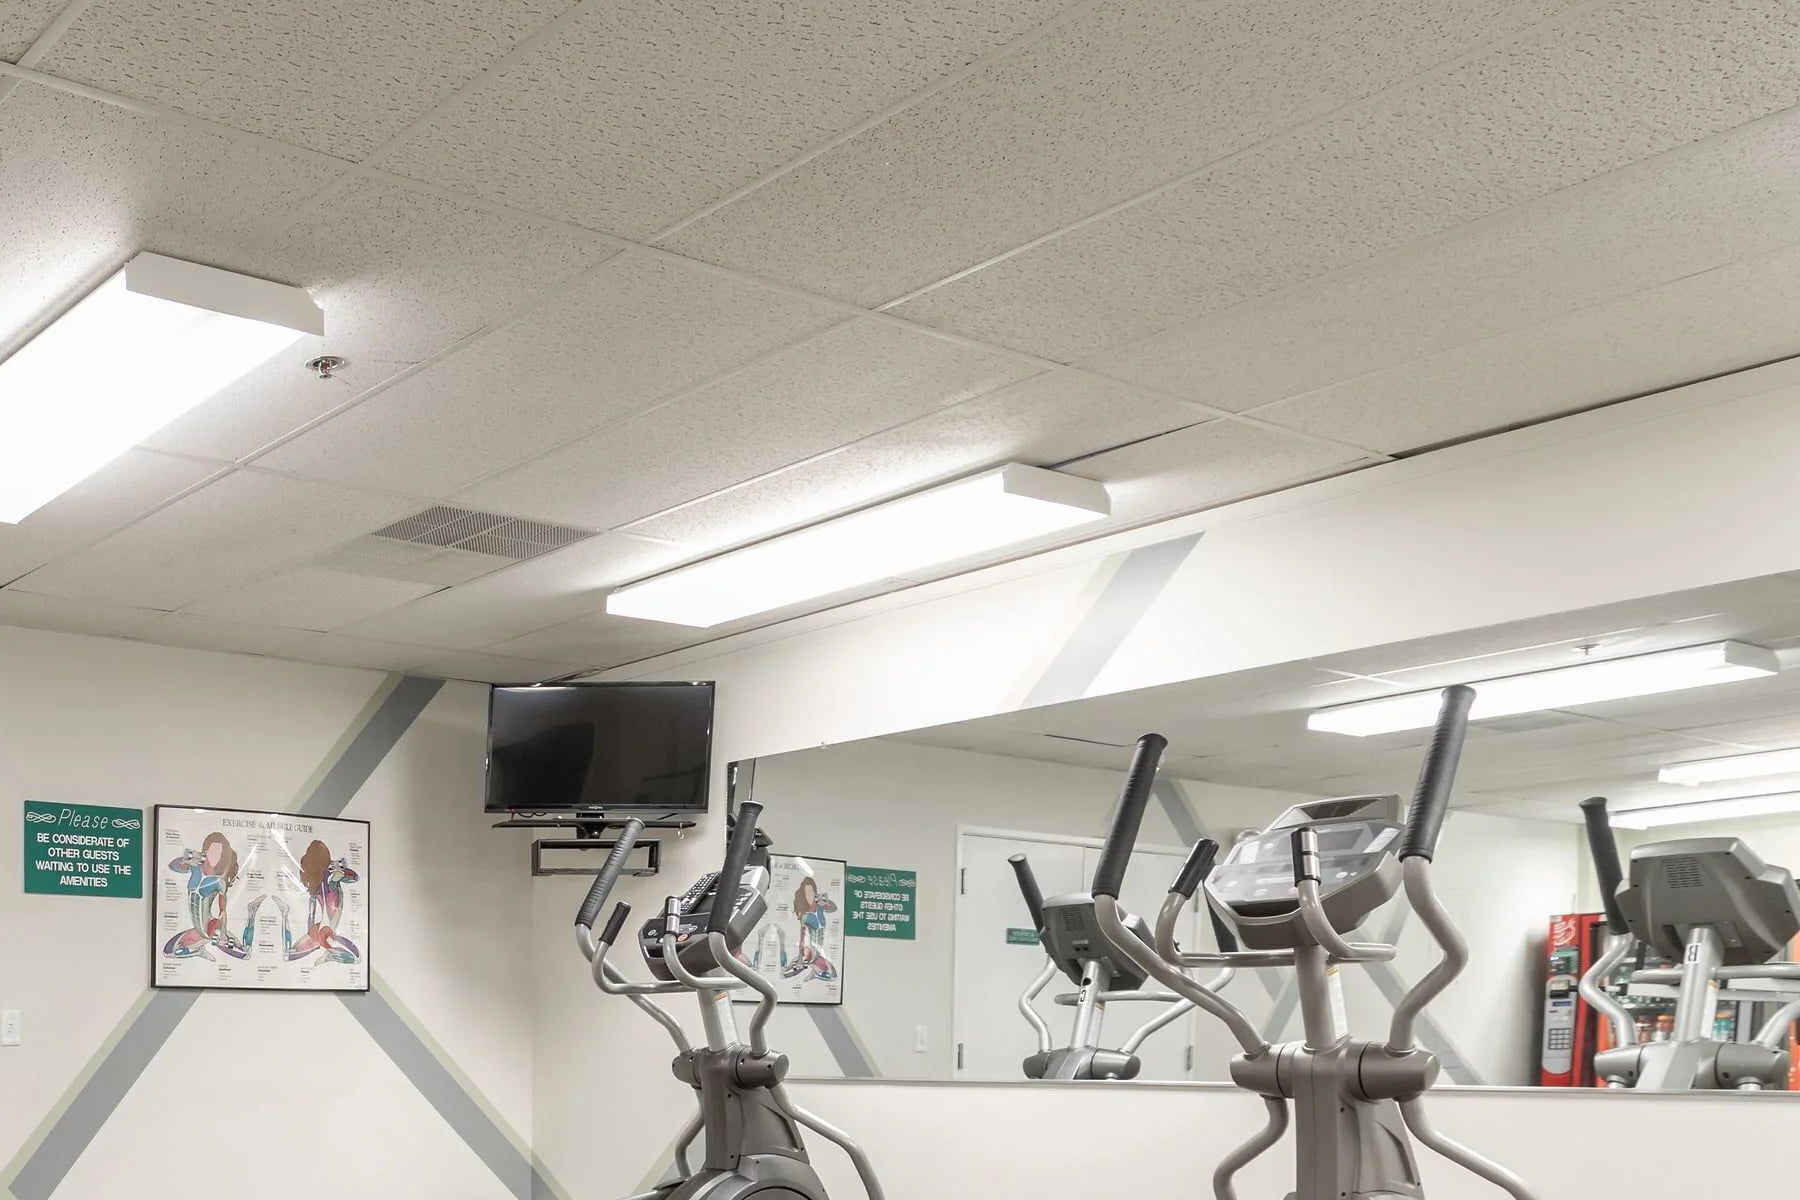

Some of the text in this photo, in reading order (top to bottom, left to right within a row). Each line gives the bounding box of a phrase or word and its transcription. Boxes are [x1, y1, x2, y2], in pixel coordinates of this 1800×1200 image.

[58, 808, 109, 829] Please
[222, 818, 256, 829] EXERCISE
[293, 824, 314, 833] GUIDE
[37, 833, 130, 848] BE CONSIDERATE OF
[47, 847, 120, 861] OTHER GUESTS
[35, 860, 132, 875] WAITING TO USE THE
[59, 875, 108, 887] AMENITIES
